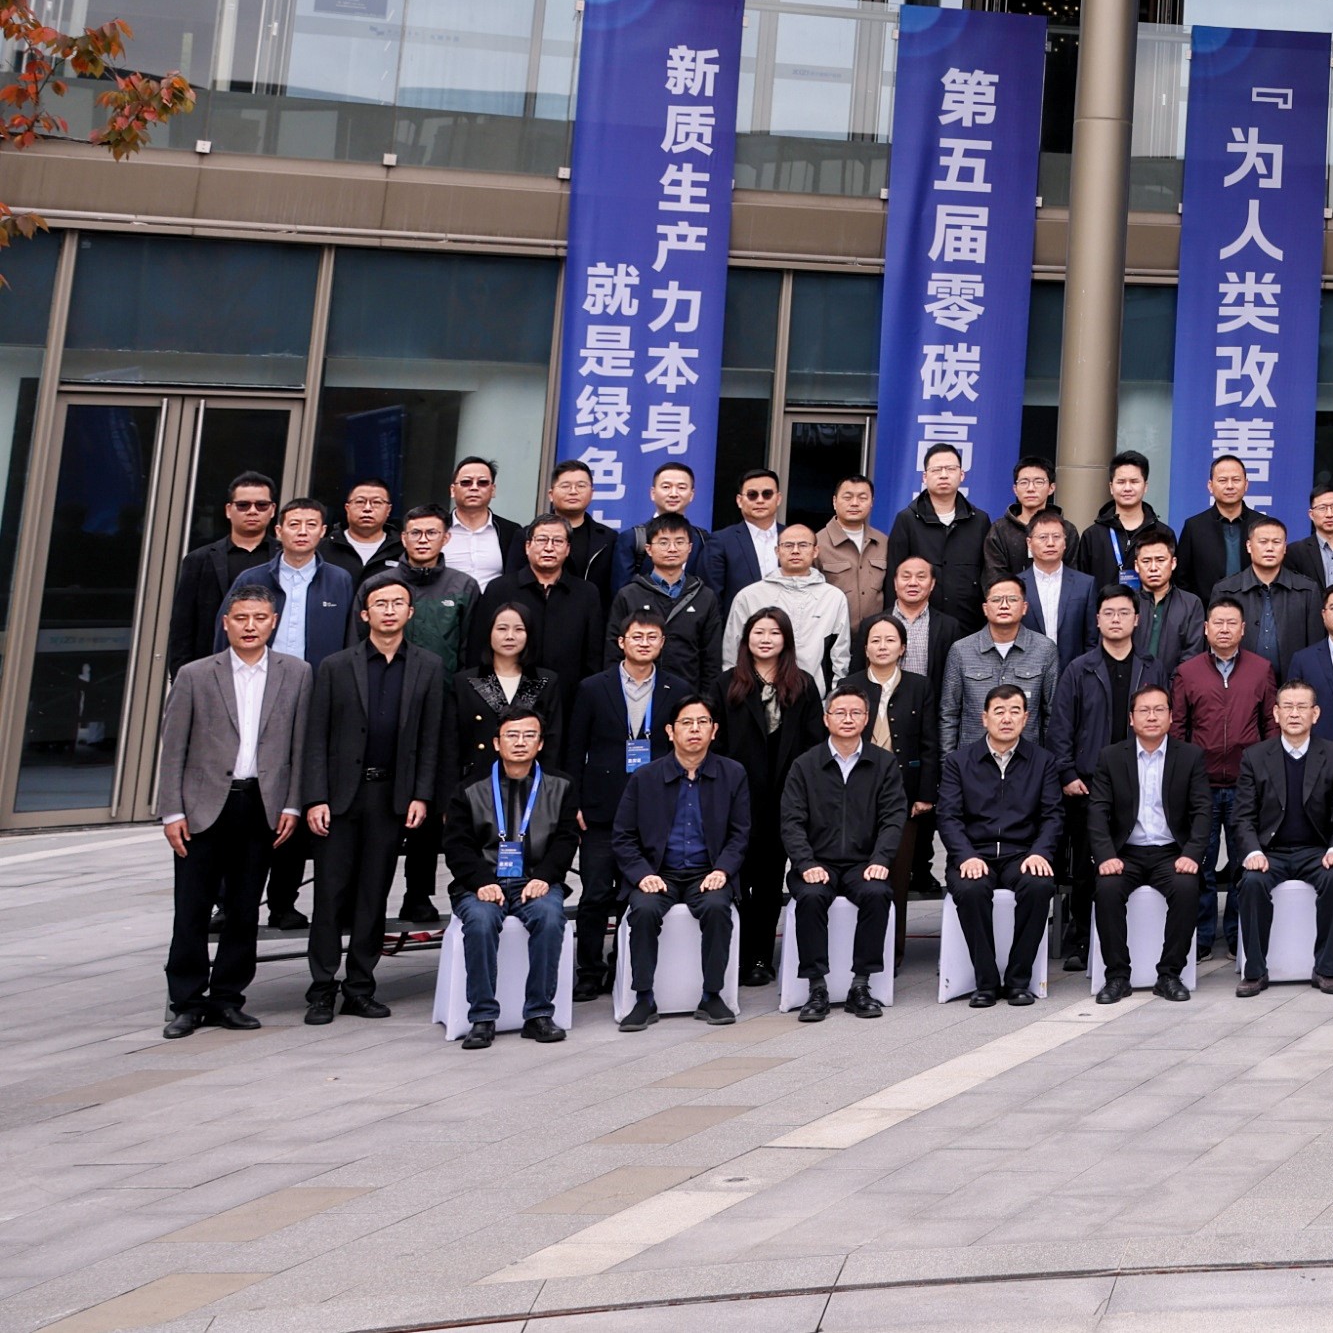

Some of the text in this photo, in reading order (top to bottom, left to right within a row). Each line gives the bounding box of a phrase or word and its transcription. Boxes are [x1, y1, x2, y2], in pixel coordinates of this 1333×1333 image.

[573, 262, 640, 529] 就是绿色
[640, 45, 720, 455] 新质生产力本身
[912, 67, 999, 500] 第五届零碳高
[1209, 87, 1293, 515] 『为人类改善
